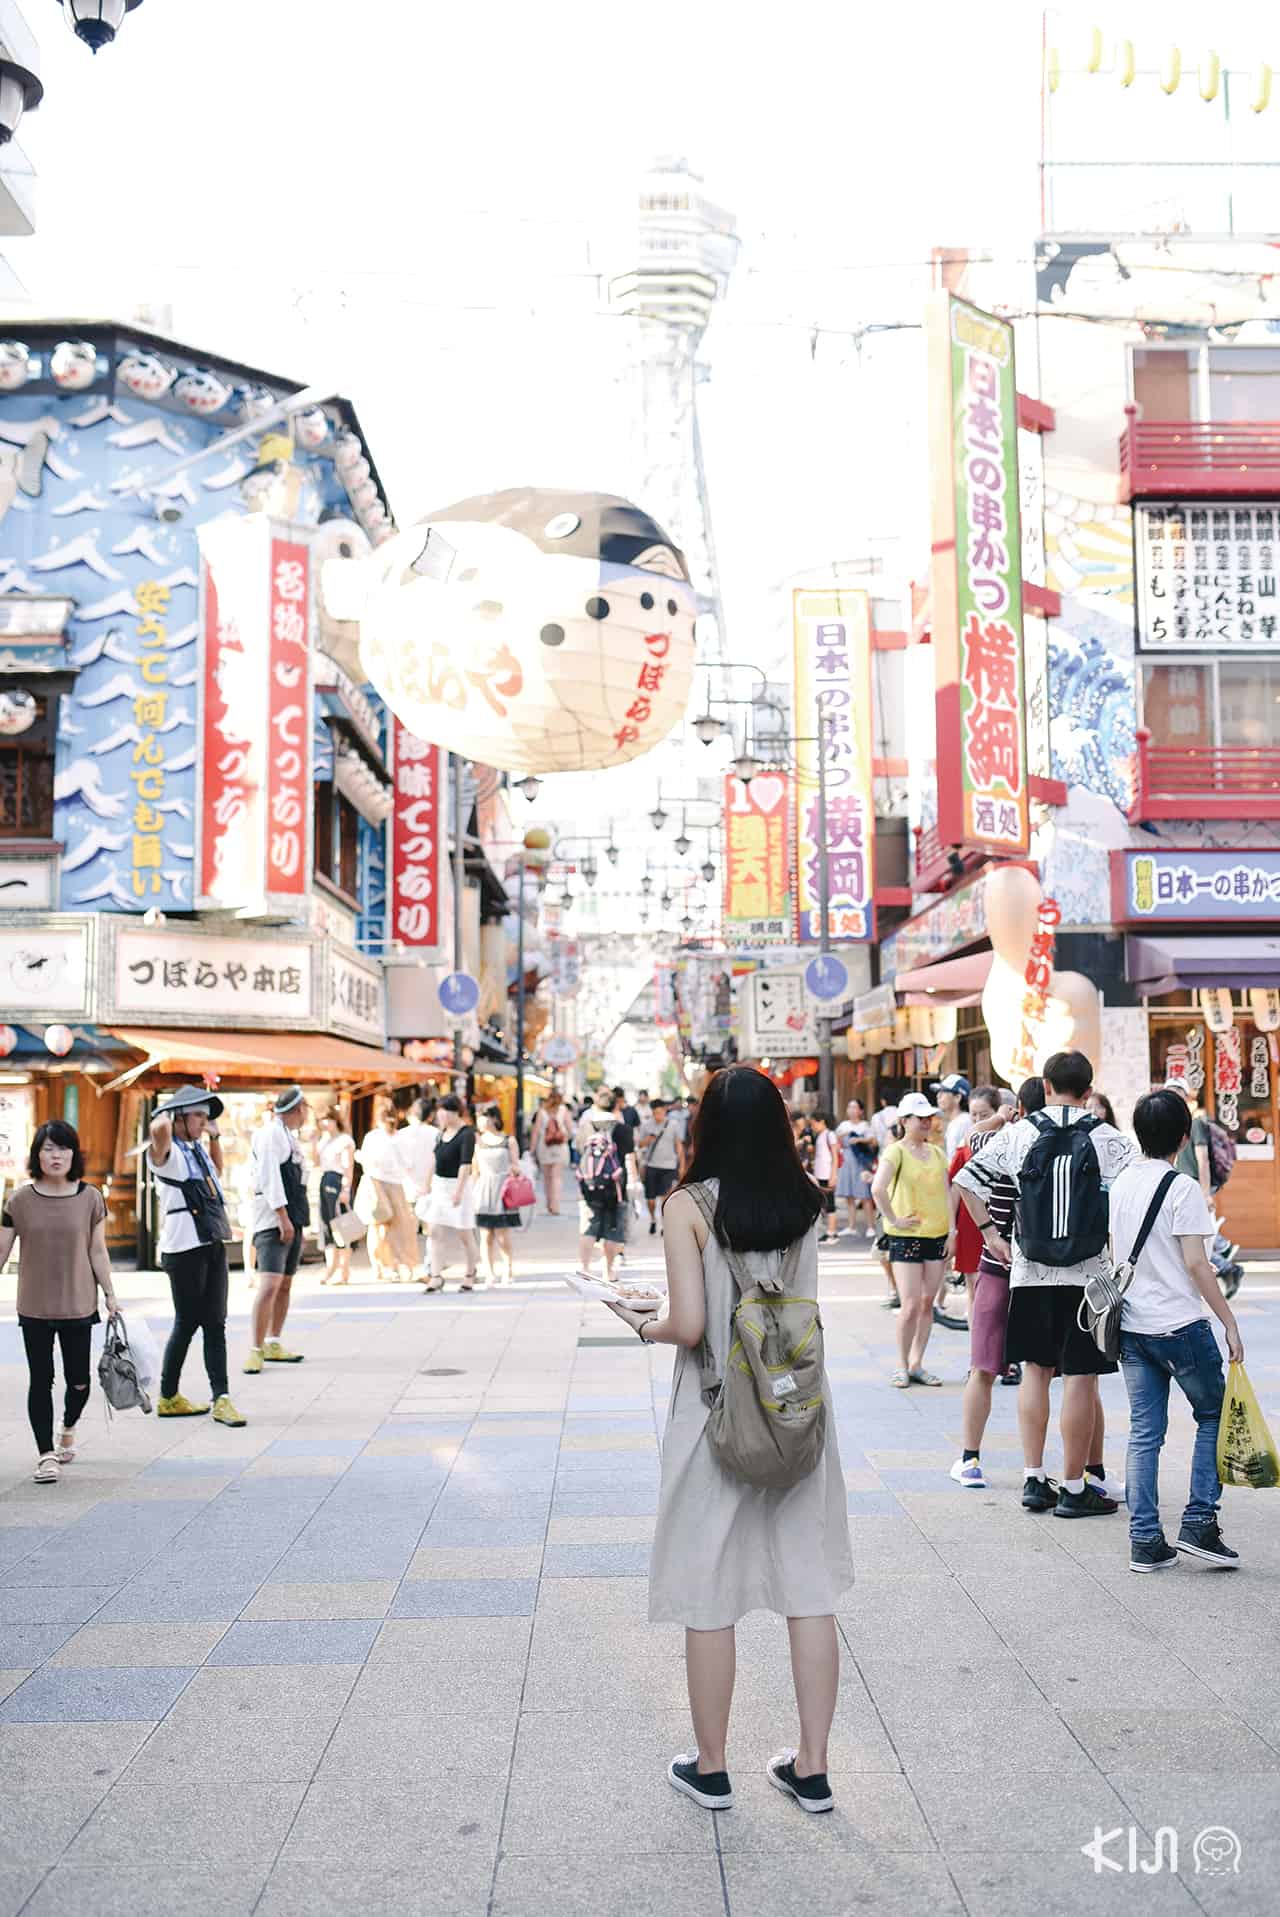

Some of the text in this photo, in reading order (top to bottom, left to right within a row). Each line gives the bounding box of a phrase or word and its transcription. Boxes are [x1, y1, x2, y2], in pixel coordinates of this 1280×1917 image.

[1215, 576, 1232, 639] にんにく
[975, 800, 1019, 837] 酒処
